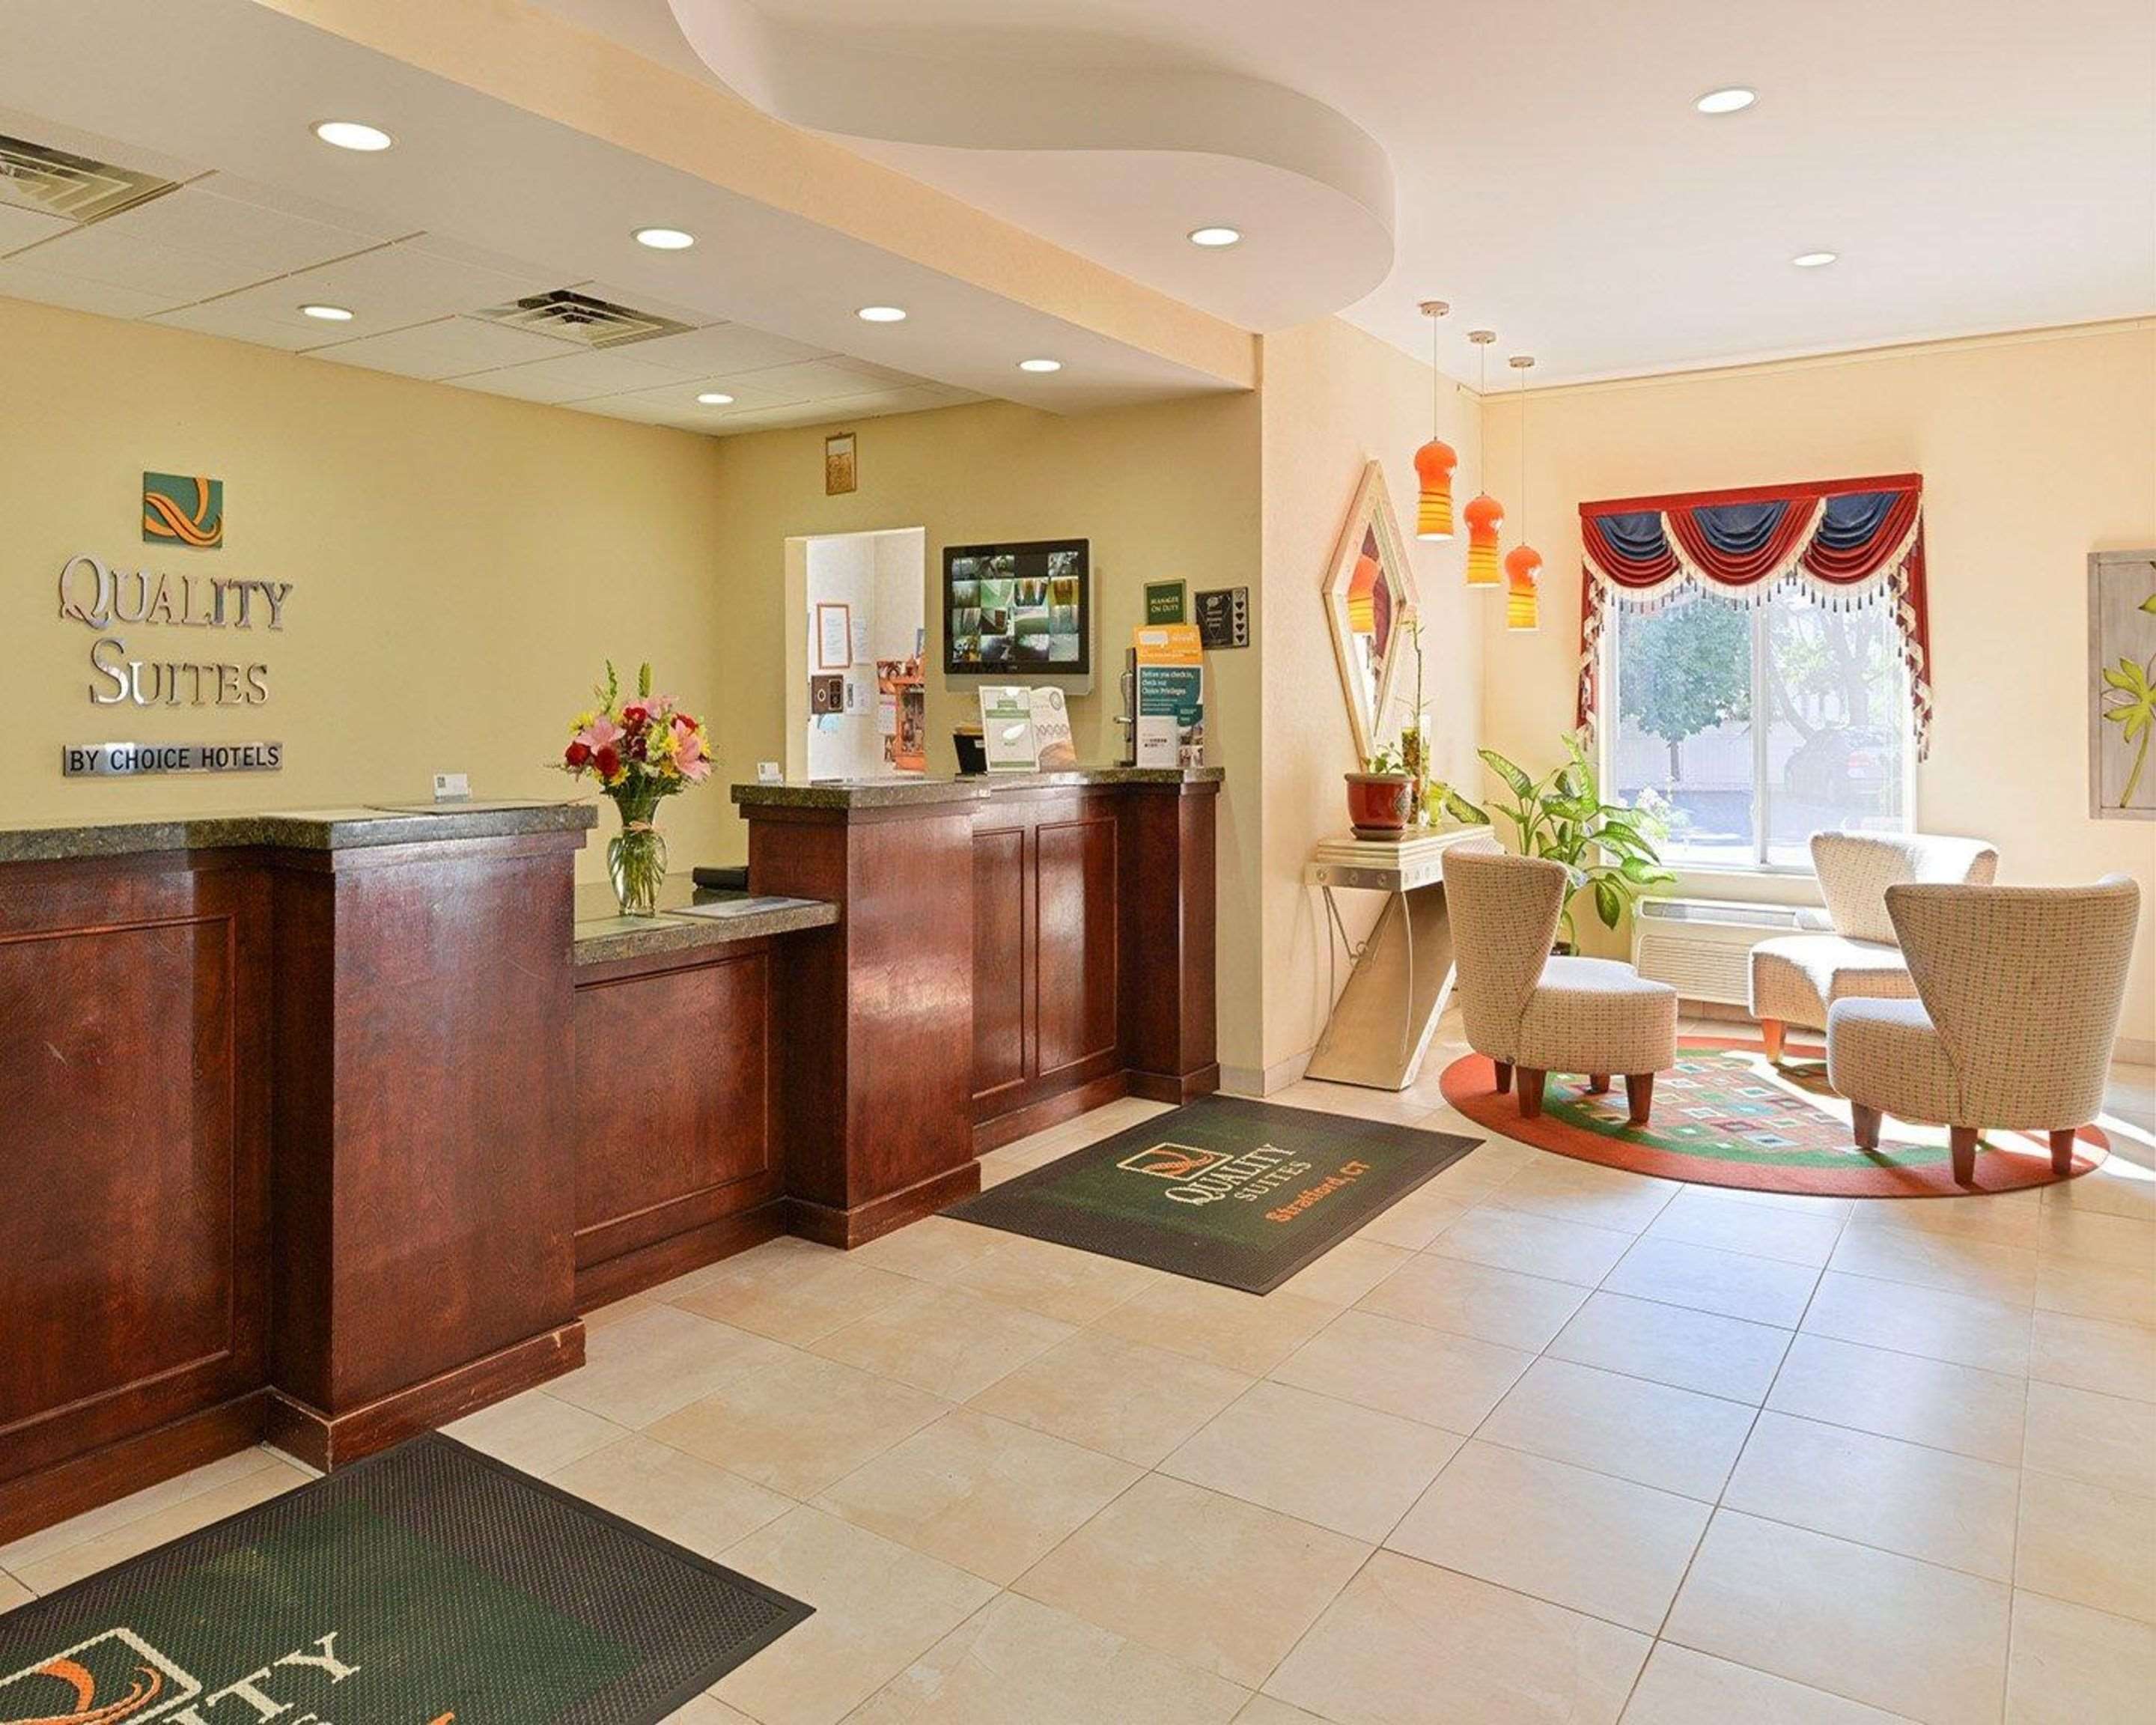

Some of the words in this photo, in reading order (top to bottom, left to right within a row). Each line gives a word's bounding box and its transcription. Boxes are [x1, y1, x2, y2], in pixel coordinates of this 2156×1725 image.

[59, 553, 293, 631] QUALITY
[89, 636, 270, 706] SUITES
[70, 749, 99, 772] BY
[109, 748, 191, 770] CHOICE
[201, 746, 280, 768] HOTELS
[1165, 1143, 1297, 1205] QUALITY
[1234, 1160, 1312, 1202] SUITES
